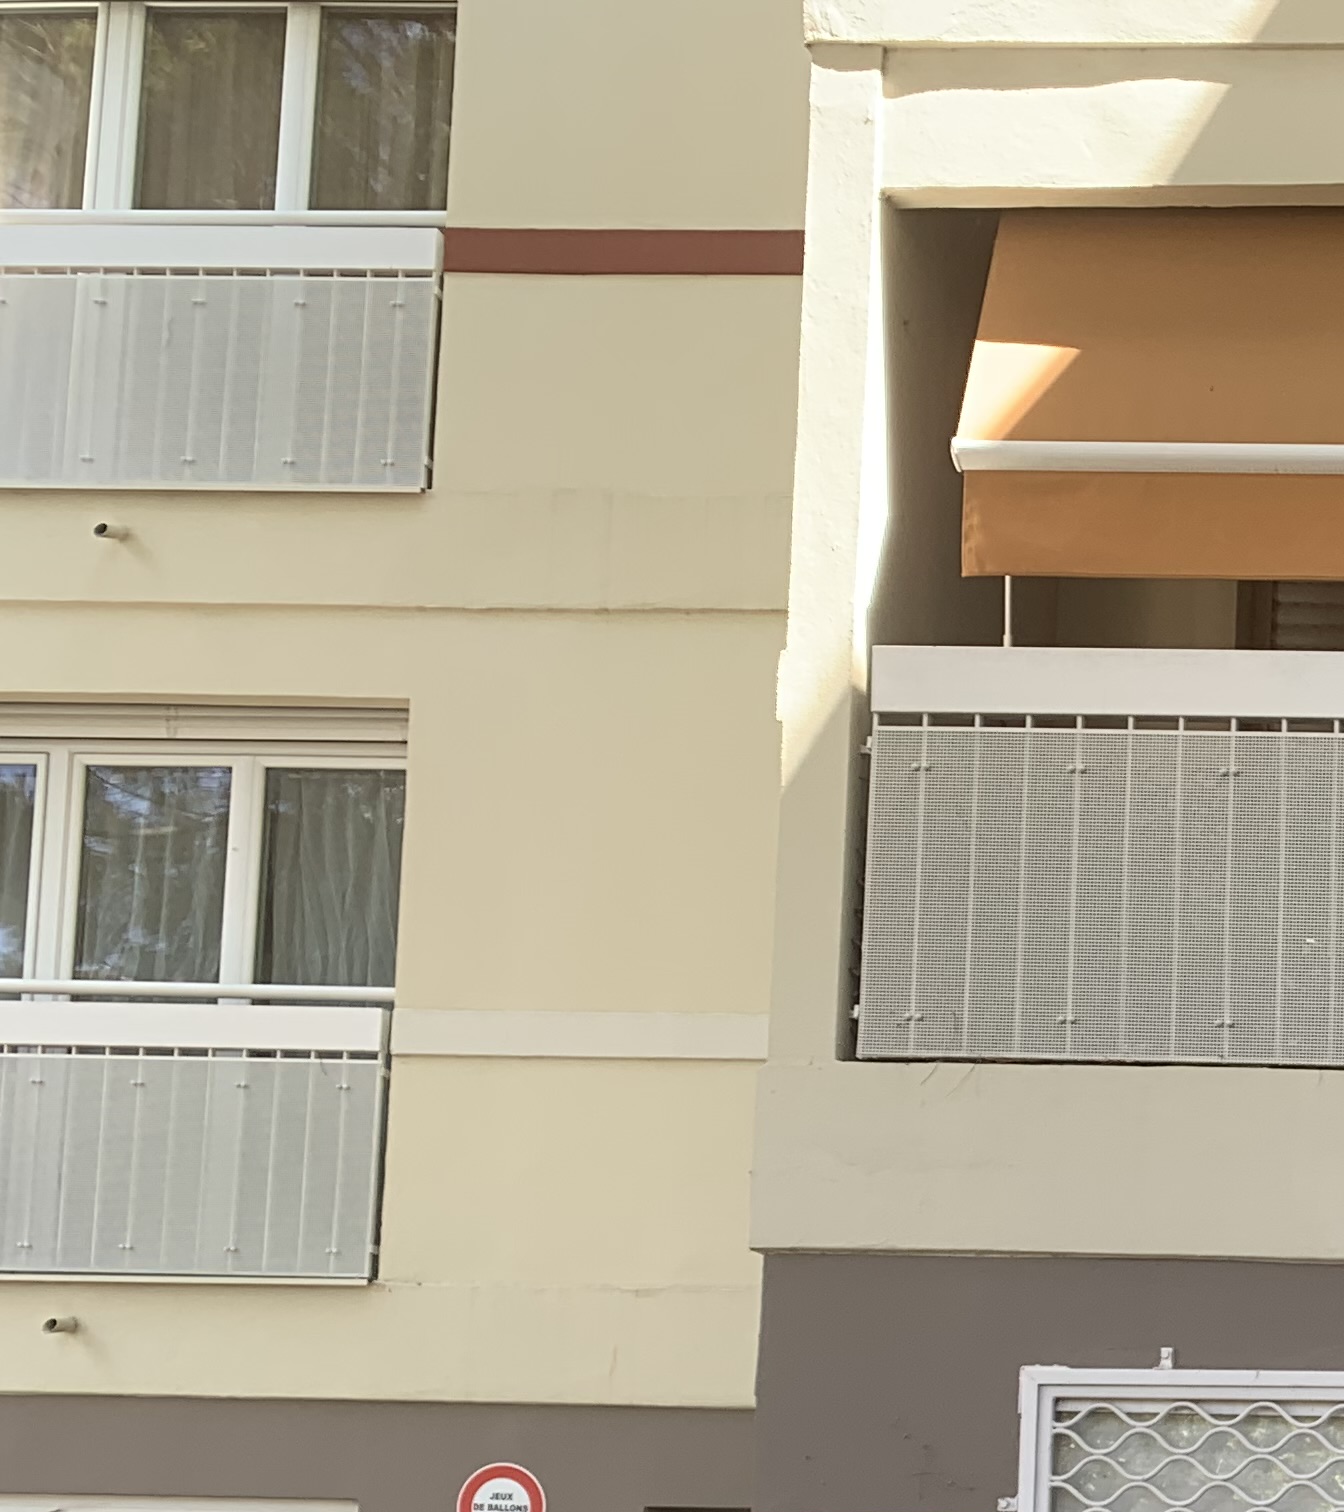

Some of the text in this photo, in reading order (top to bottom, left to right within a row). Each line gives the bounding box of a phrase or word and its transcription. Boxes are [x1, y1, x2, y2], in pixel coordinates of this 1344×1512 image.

[489, 1493, 513, 1501] JEUX
[473, 1503, 528, 1512] DE BALLONS
